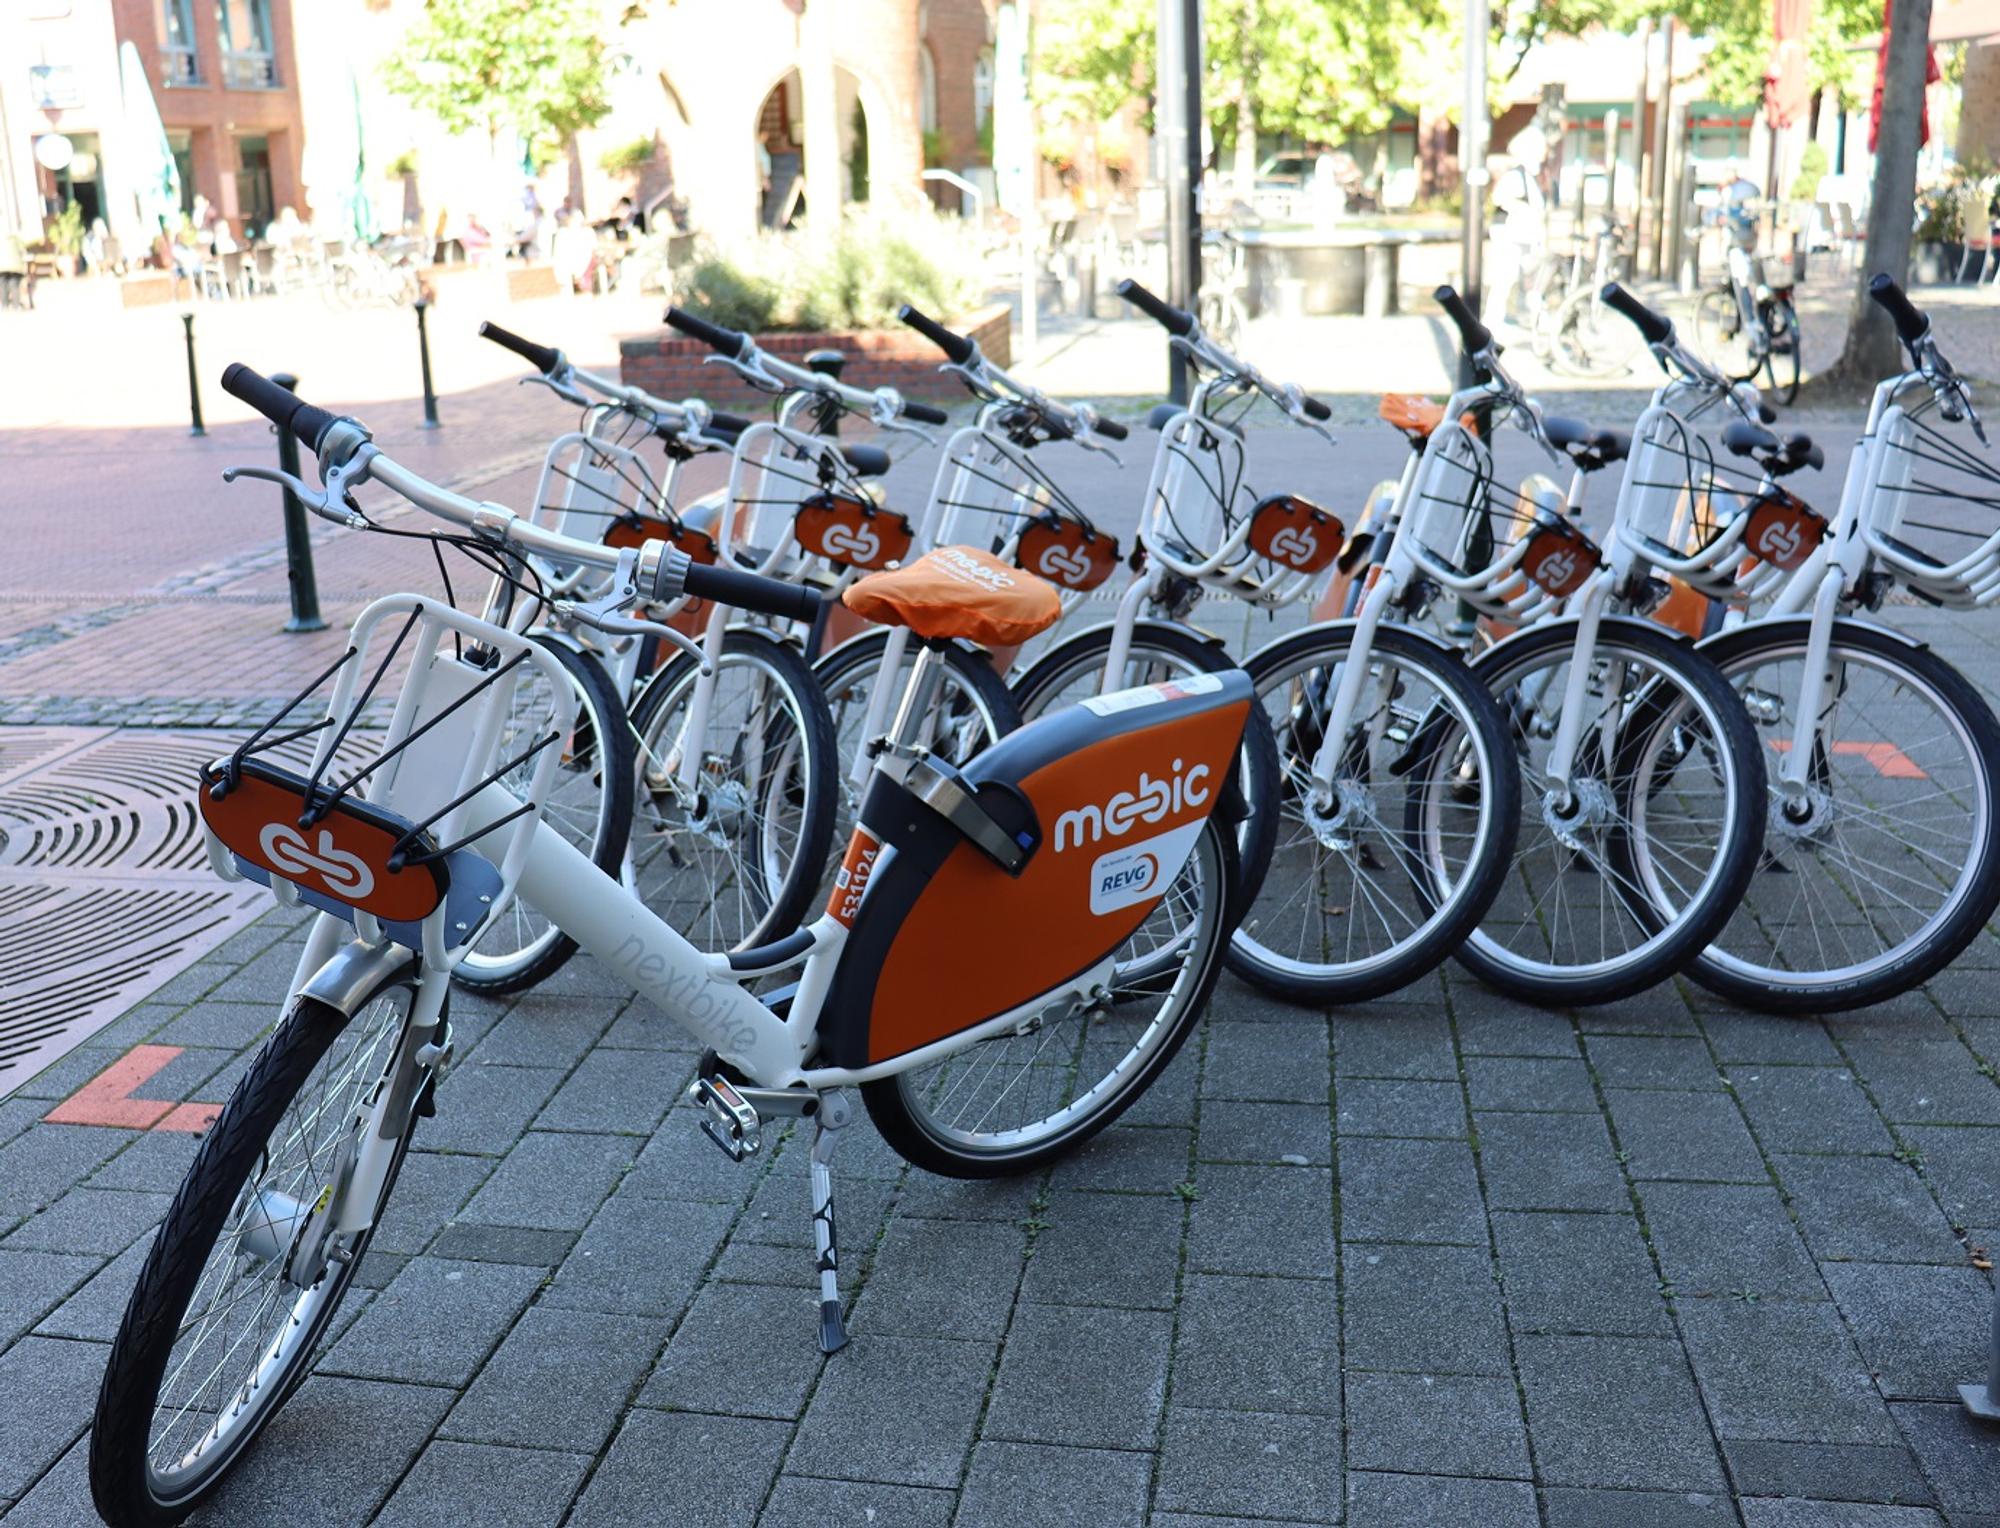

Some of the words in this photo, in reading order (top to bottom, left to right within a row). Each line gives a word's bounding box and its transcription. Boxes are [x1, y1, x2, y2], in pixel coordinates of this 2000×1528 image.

[1054, 758, 1209, 852] mobic
[841, 849, 877, 918] 531124
[1101, 864, 1146, 892] REVG
[612, 933, 757, 1052] nextbike
